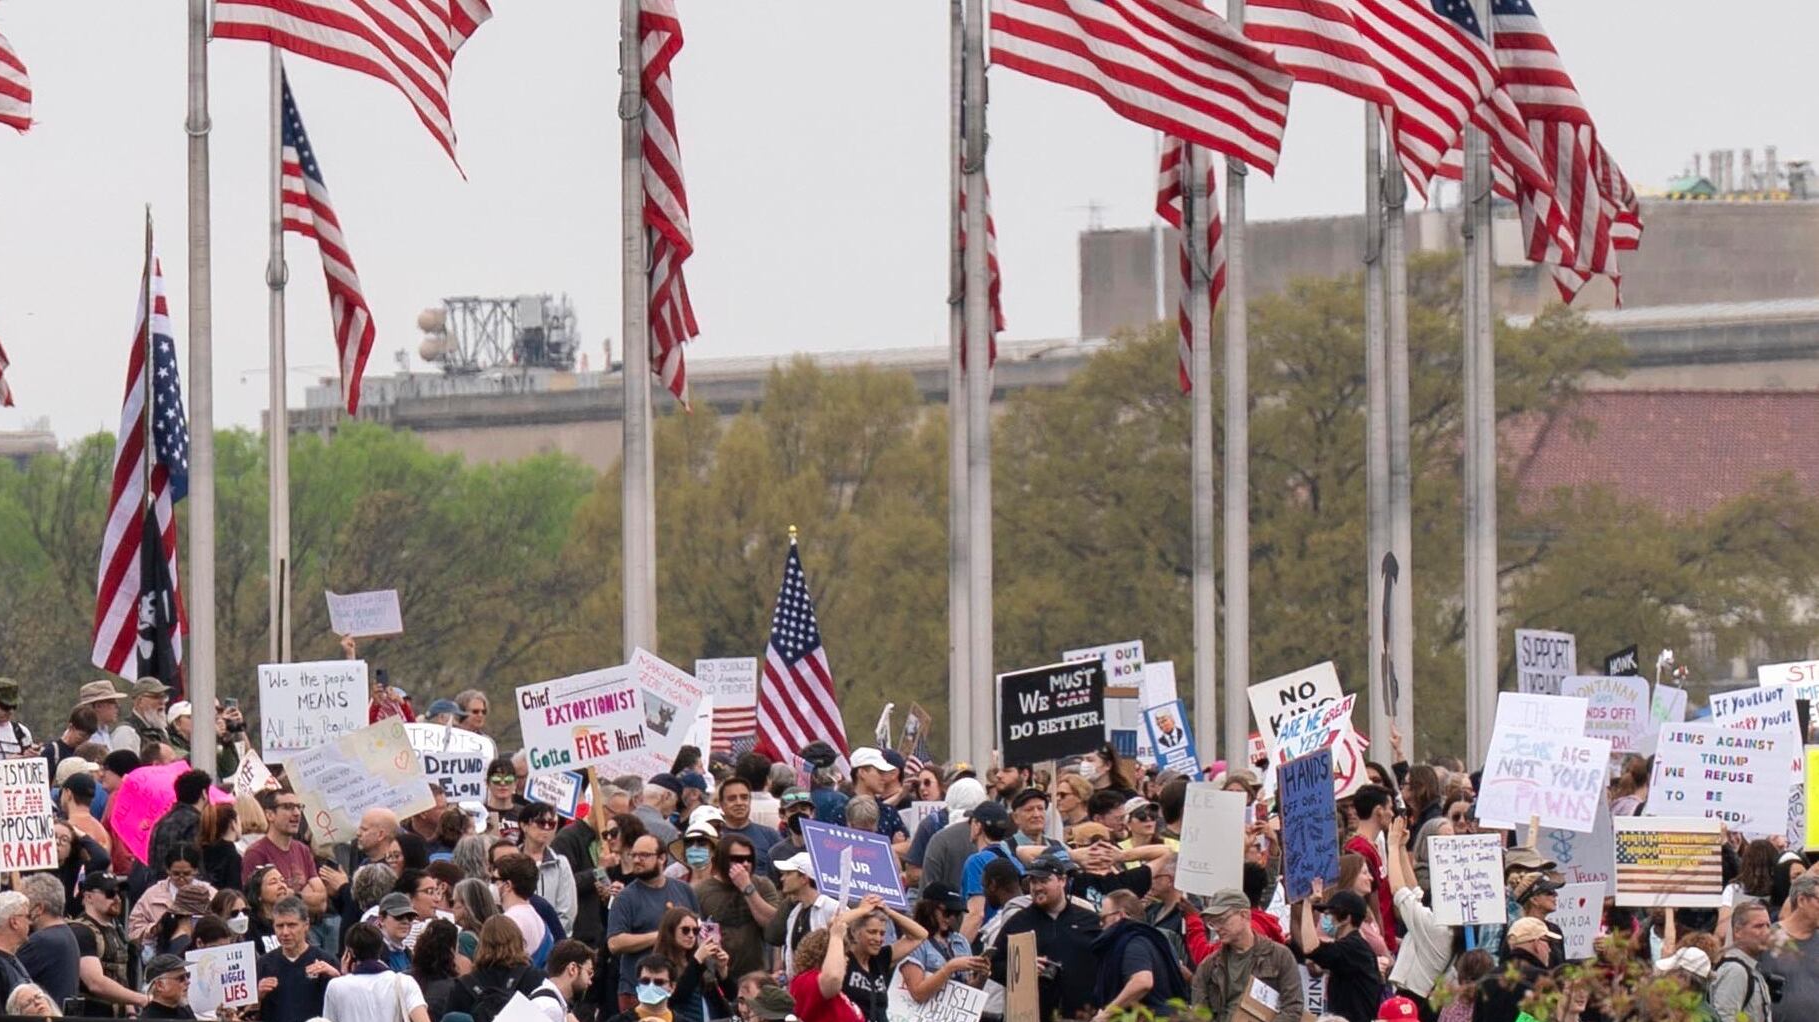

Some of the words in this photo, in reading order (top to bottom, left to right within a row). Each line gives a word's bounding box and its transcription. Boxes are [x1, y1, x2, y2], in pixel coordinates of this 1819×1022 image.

[1115, 647, 1139, 661] OUT
[1522, 636, 1570, 669] SUPPORT
[1114, 662, 1142, 677] NOW
[1609, 652, 1638, 675] HONK
[300, 671, 320, 687] the
[1049, 668, 1097, 689] MUST
[297, 691, 349, 711] MEANS
[522, 688, 550, 710] Chief
[1056, 690, 1091, 706] CAN
[1279, 682, 1315, 706] NO
[545, 689, 635, 727] EXTORTIONIST
[1714, 700, 1728, 718] IF
[266, 717, 284, 738] All
[297, 717, 313, 736] the
[1010, 723, 1034, 741] DO
[1037, 711, 1105, 735] BETTER.
[1277, 717, 1304, 745] ARE
[1304, 708, 1323, 732] WE
[1321, 697, 1353, 727] GREAT
[530, 747, 571, 770] Gotta
[575, 732, 610, 761] FIRE
[1669, 731, 1704, 745] JEWS
[1716, 735, 1775, 751] AGAINST
[425, 756, 482, 774] DEFUND
[1701, 753, 1749, 767] TRUMP
[5, 764, 16, 785] IS
[18, 762, 45, 785] MORE
[1285, 754, 1329, 796] HANDS
[1497, 757, 1543, 778] NOT
[1551, 764, 1601, 795] YOUR
[1665, 767, 1685, 778] WE
[1704, 770, 1754, 784] REFUSE
[440, 777, 480, 797] ELON
[1666, 790, 1684, 801] TO
[1705, 791, 1722, 801] BE
[1515, 785, 1592, 822] PAWNS
[1705, 809, 1748, 824] USED!
[858, 880, 900, 897] Workers
[1459, 901, 1479, 921] ME
[1558, 898, 1573, 909] WE
[227, 951, 244, 961] LIES
[221, 971, 246, 985] BIGGER
[224, 983, 248, 1003] LIES
